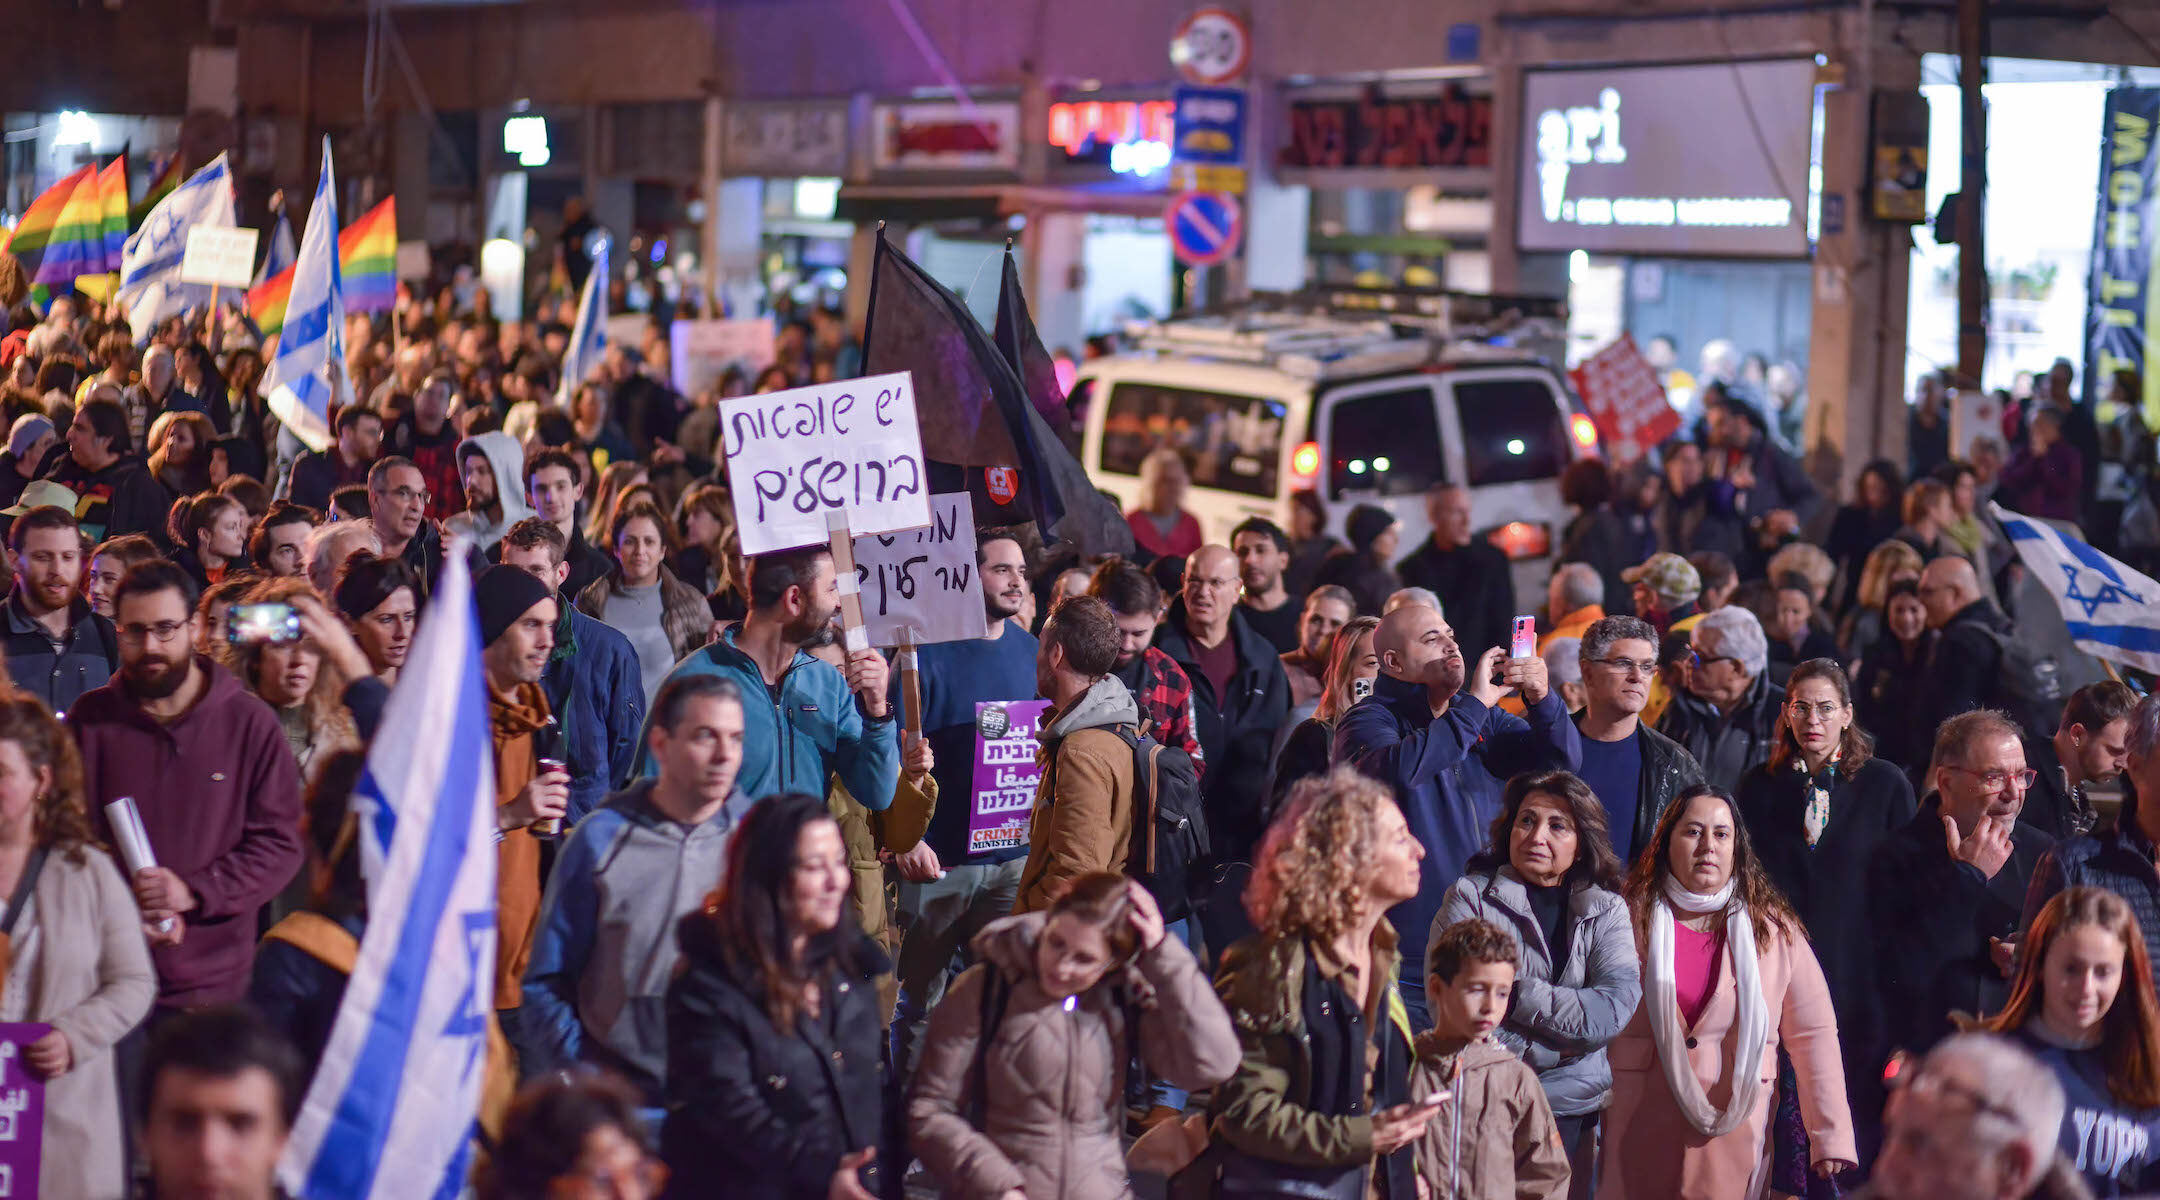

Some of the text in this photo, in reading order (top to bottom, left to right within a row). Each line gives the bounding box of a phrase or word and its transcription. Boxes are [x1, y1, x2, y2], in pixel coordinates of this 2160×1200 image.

[875, 387, 902, 427] יש
[753, 454, 919, 523] בירושלים
[934, 563, 970, 593] מר
[986, 744, 1039, 760] הבית
[982, 790, 1028, 810] כולנו
[972, 838, 1021, 850] MINISTER
[974, 828, 1023, 842] CRIME
